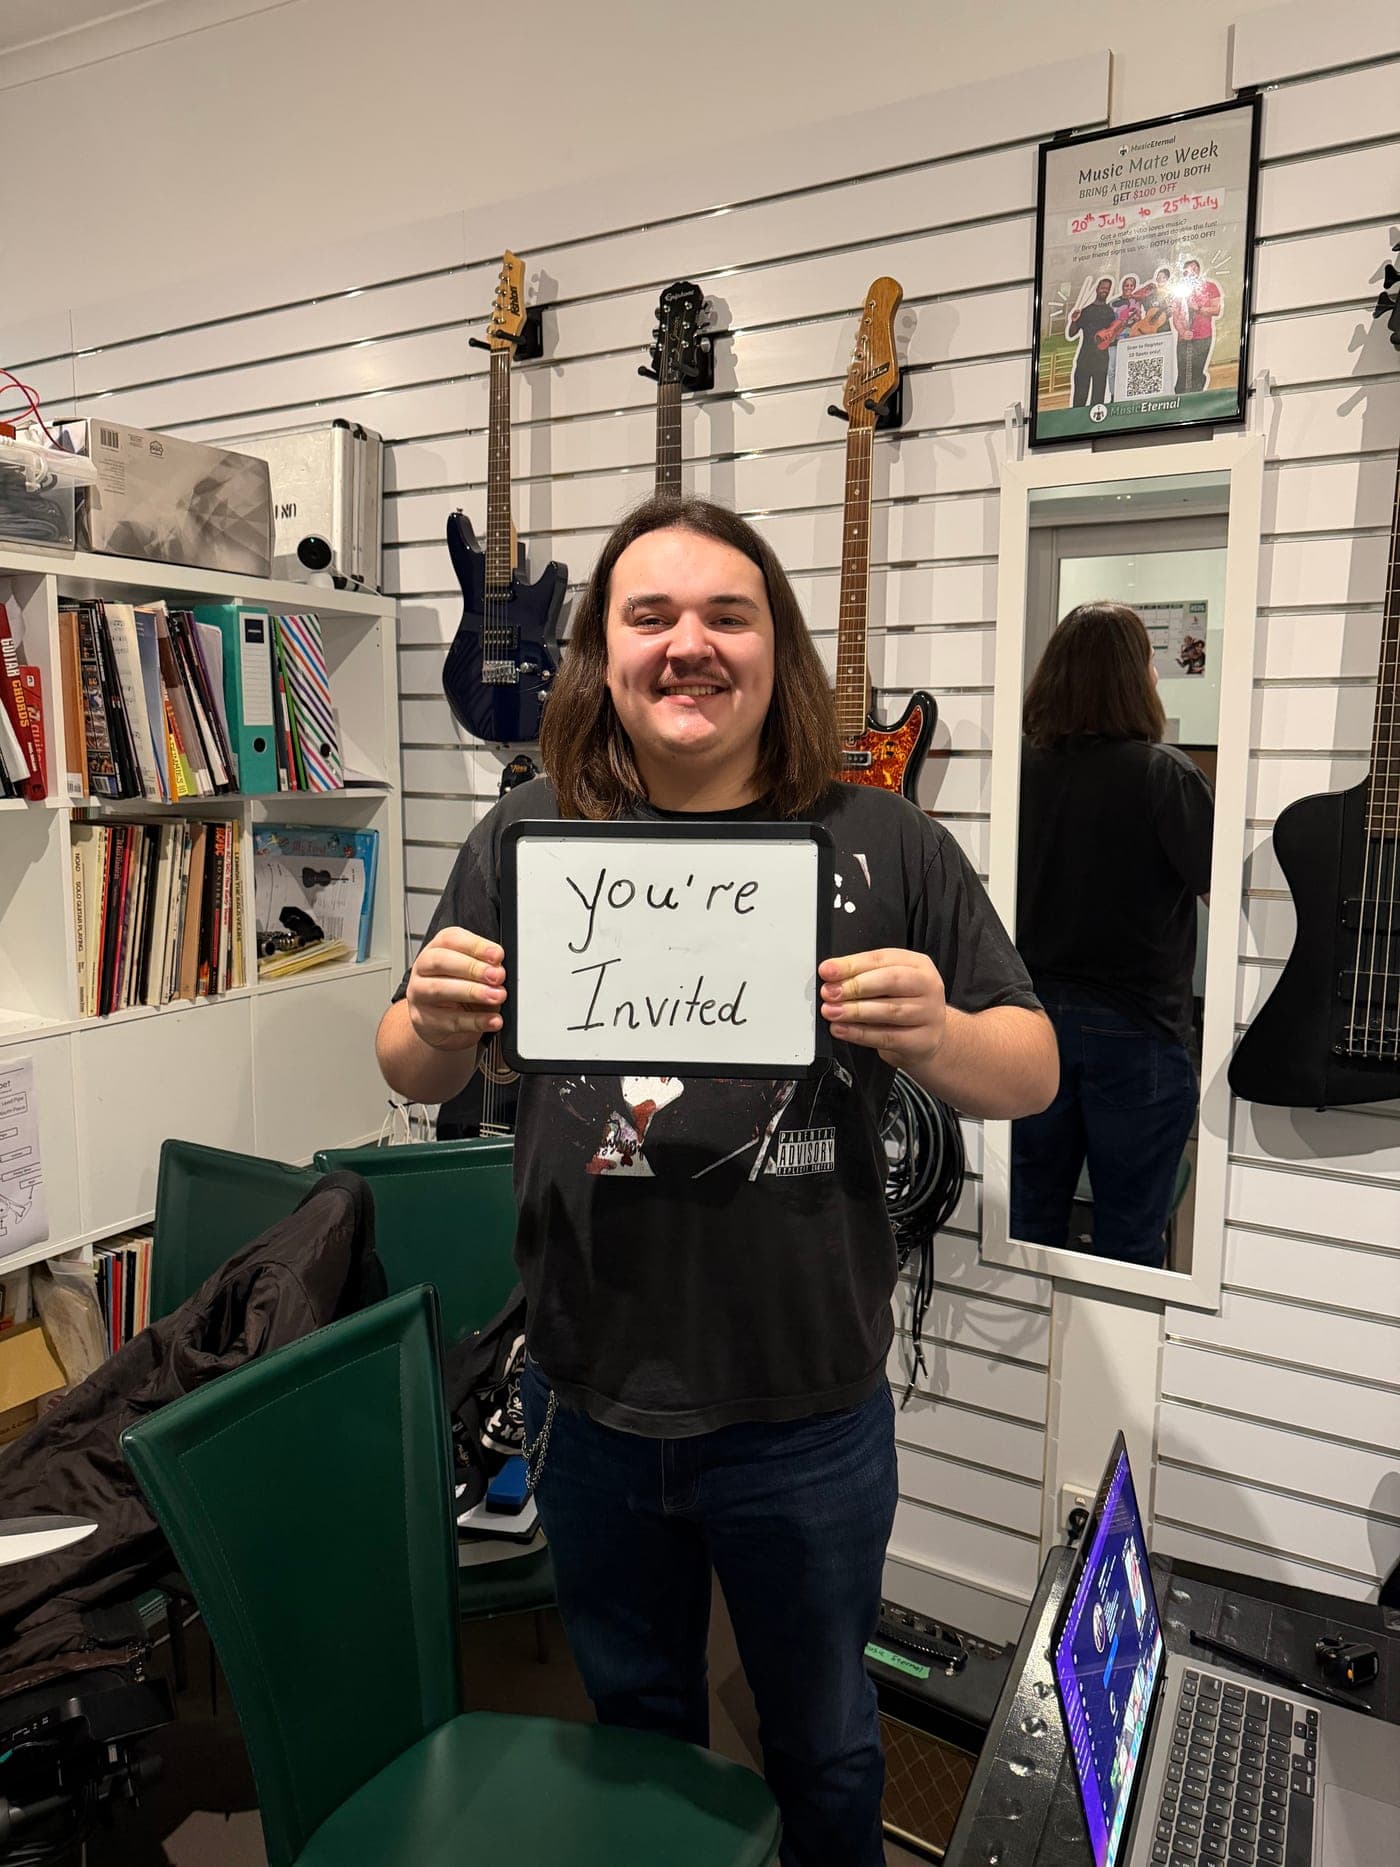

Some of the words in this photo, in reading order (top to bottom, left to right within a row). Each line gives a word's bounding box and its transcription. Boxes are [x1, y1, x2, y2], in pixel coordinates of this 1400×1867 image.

[1131, 136, 1176, 153] MusicEternal
[1078, 164, 1123, 185] Music
[1129, 154, 1169, 173] Mate
[1175, 142, 1219, 163] Week
[1079, 184, 1108, 199] BRING
[1110, 183, 1118, 193] A
[1120, 175, 1158, 191] FRIEND,
[1160, 172, 1180, 183] YOU
[1184, 164, 1211, 177] BOTH
[1112, 192, 1131, 206] GET
[1132, 187, 1156, 200] $100
[1159, 183, 1177, 194] OFF
[1071, 213, 1095, 234] 20th
[1098, 213, 1126, 229] July
[1138, 208, 1151, 217] to
[1163, 195, 1190, 214] 25th
[1192, 195, 1218, 210] July
[509, 284, 521, 317] Ashton
[1109, 397, 1180, 417] MusicEternal
[1, 637, 20, 678] GUITAR
[12, 679, 29, 728] CHORDS
[567, 958, 747, 1031] Invited
[780, 1141, 833, 1166] ADVISORY
